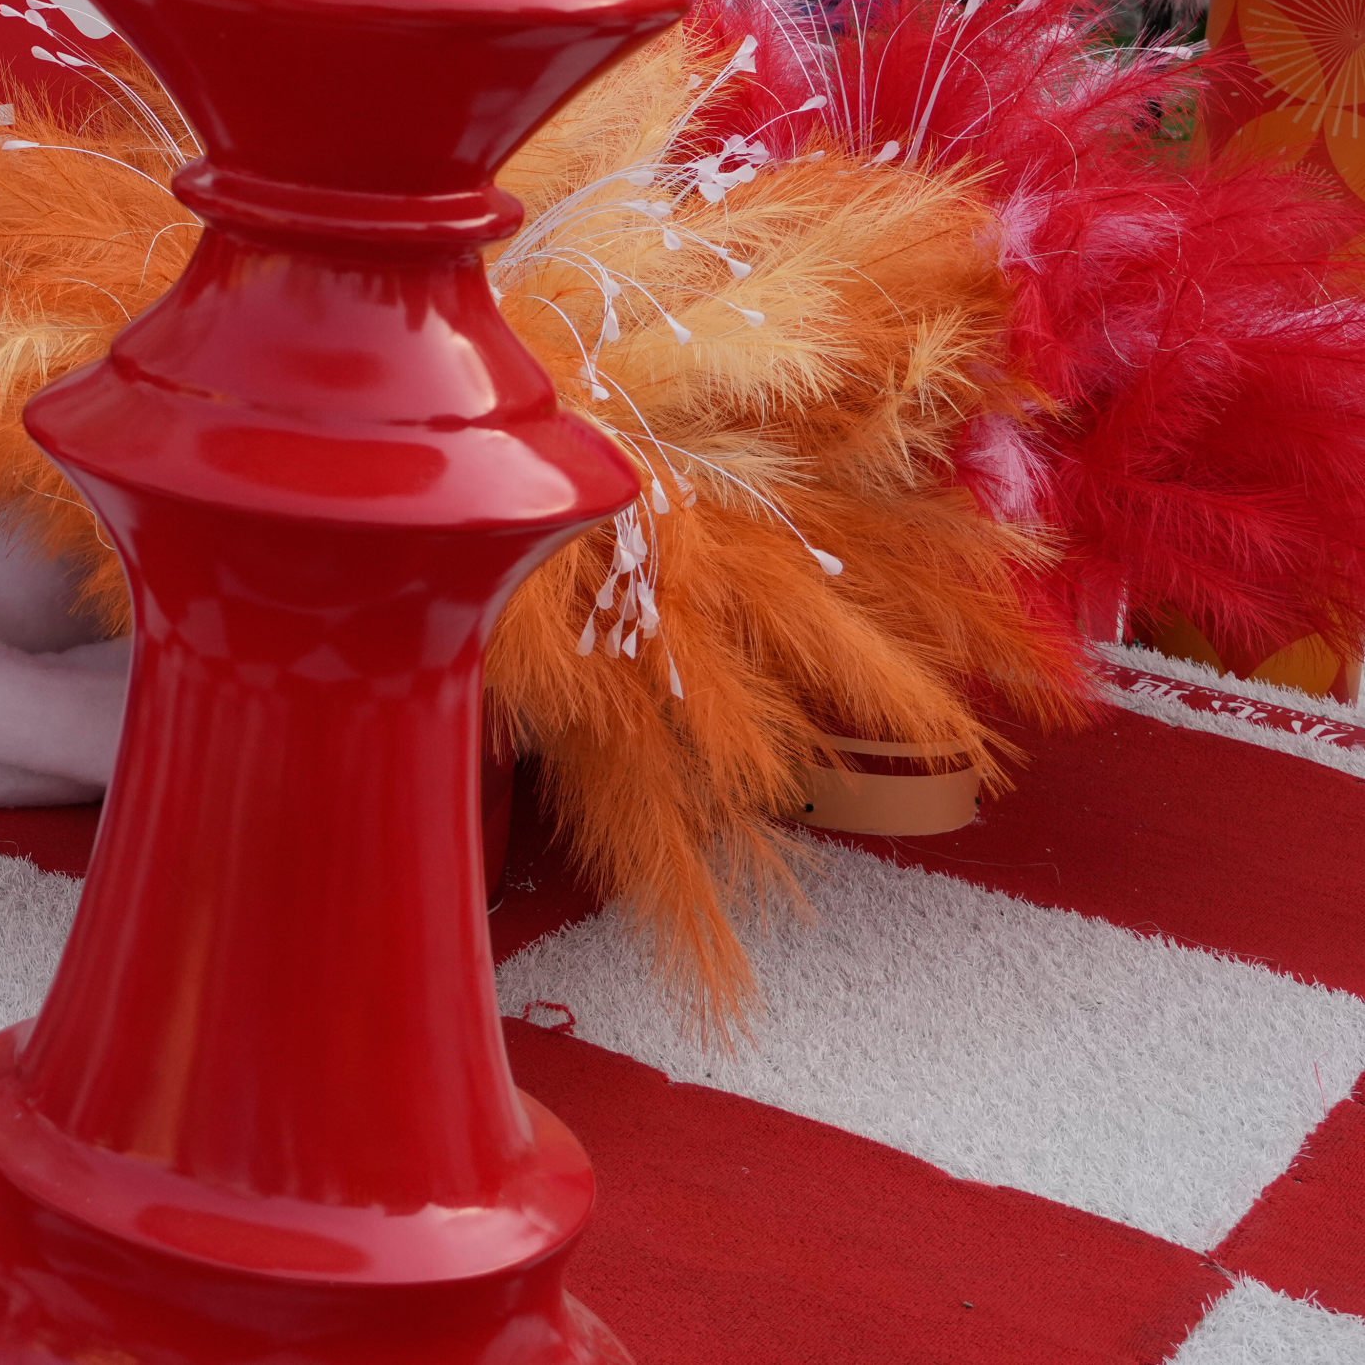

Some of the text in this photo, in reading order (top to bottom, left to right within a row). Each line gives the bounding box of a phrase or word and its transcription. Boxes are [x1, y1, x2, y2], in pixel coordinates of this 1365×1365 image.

[1105, 671, 1350, 741] 小心地
[1241, 697, 1356, 732] CAUTION
